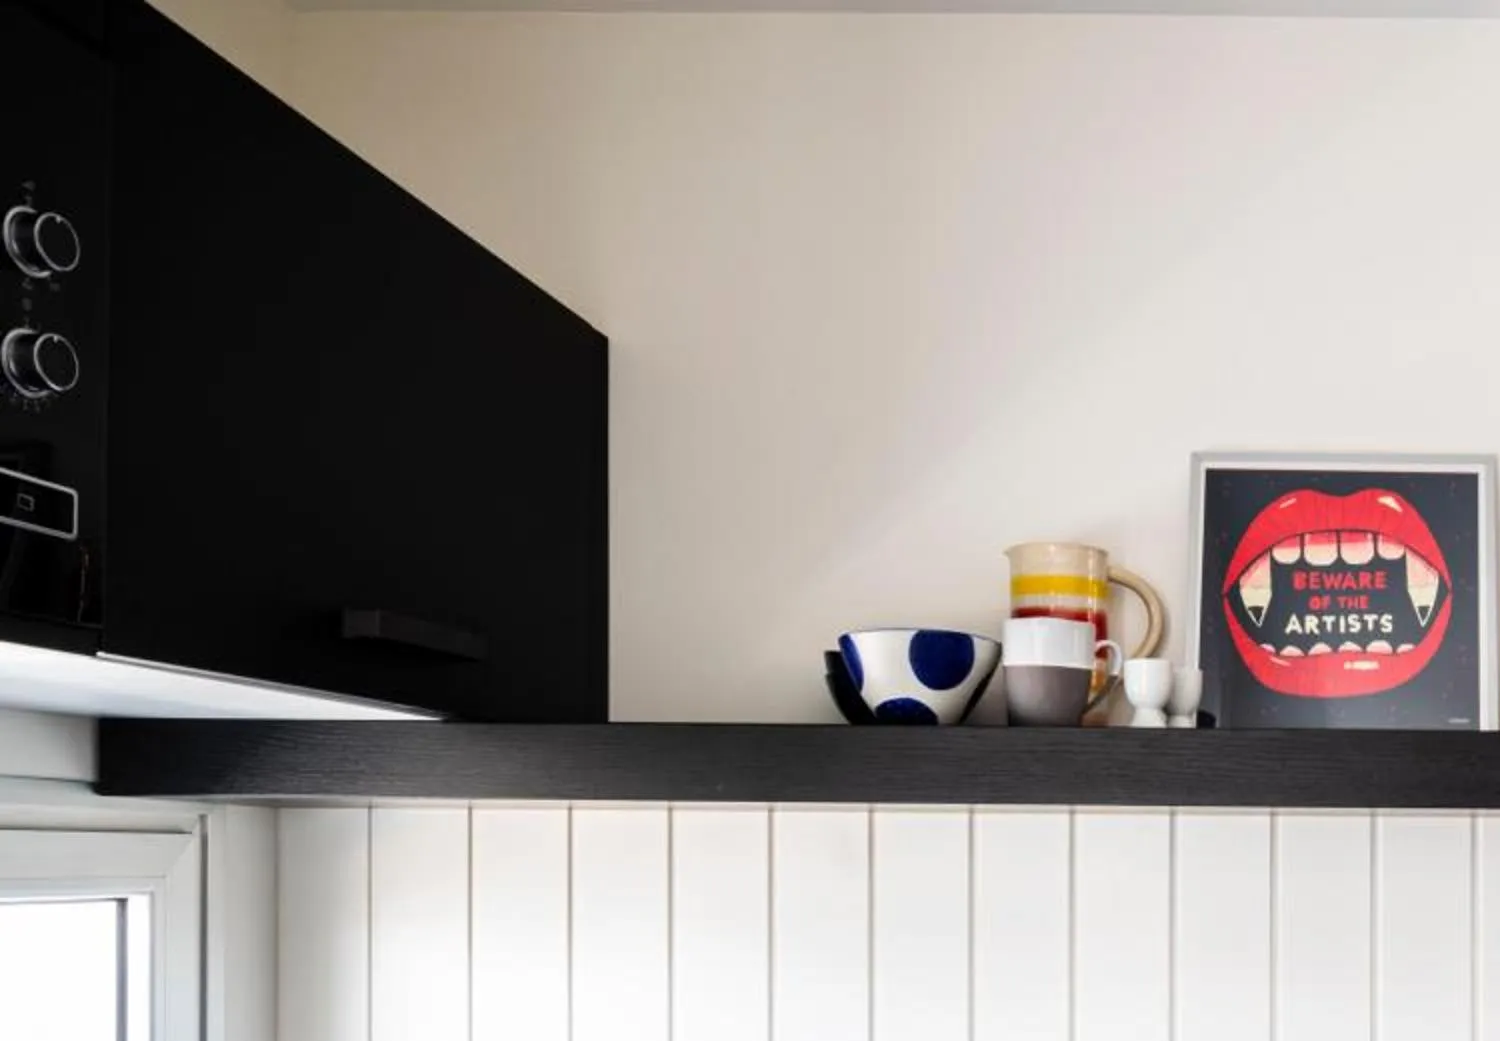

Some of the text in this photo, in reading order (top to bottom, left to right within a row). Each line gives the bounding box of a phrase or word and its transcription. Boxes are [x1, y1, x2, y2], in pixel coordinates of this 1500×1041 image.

[1293, 571, 1387, 590] BEWARE
[1308, 596, 1369, 610] OF THE
[1285, 614, 1393, 635] ARTISTS
